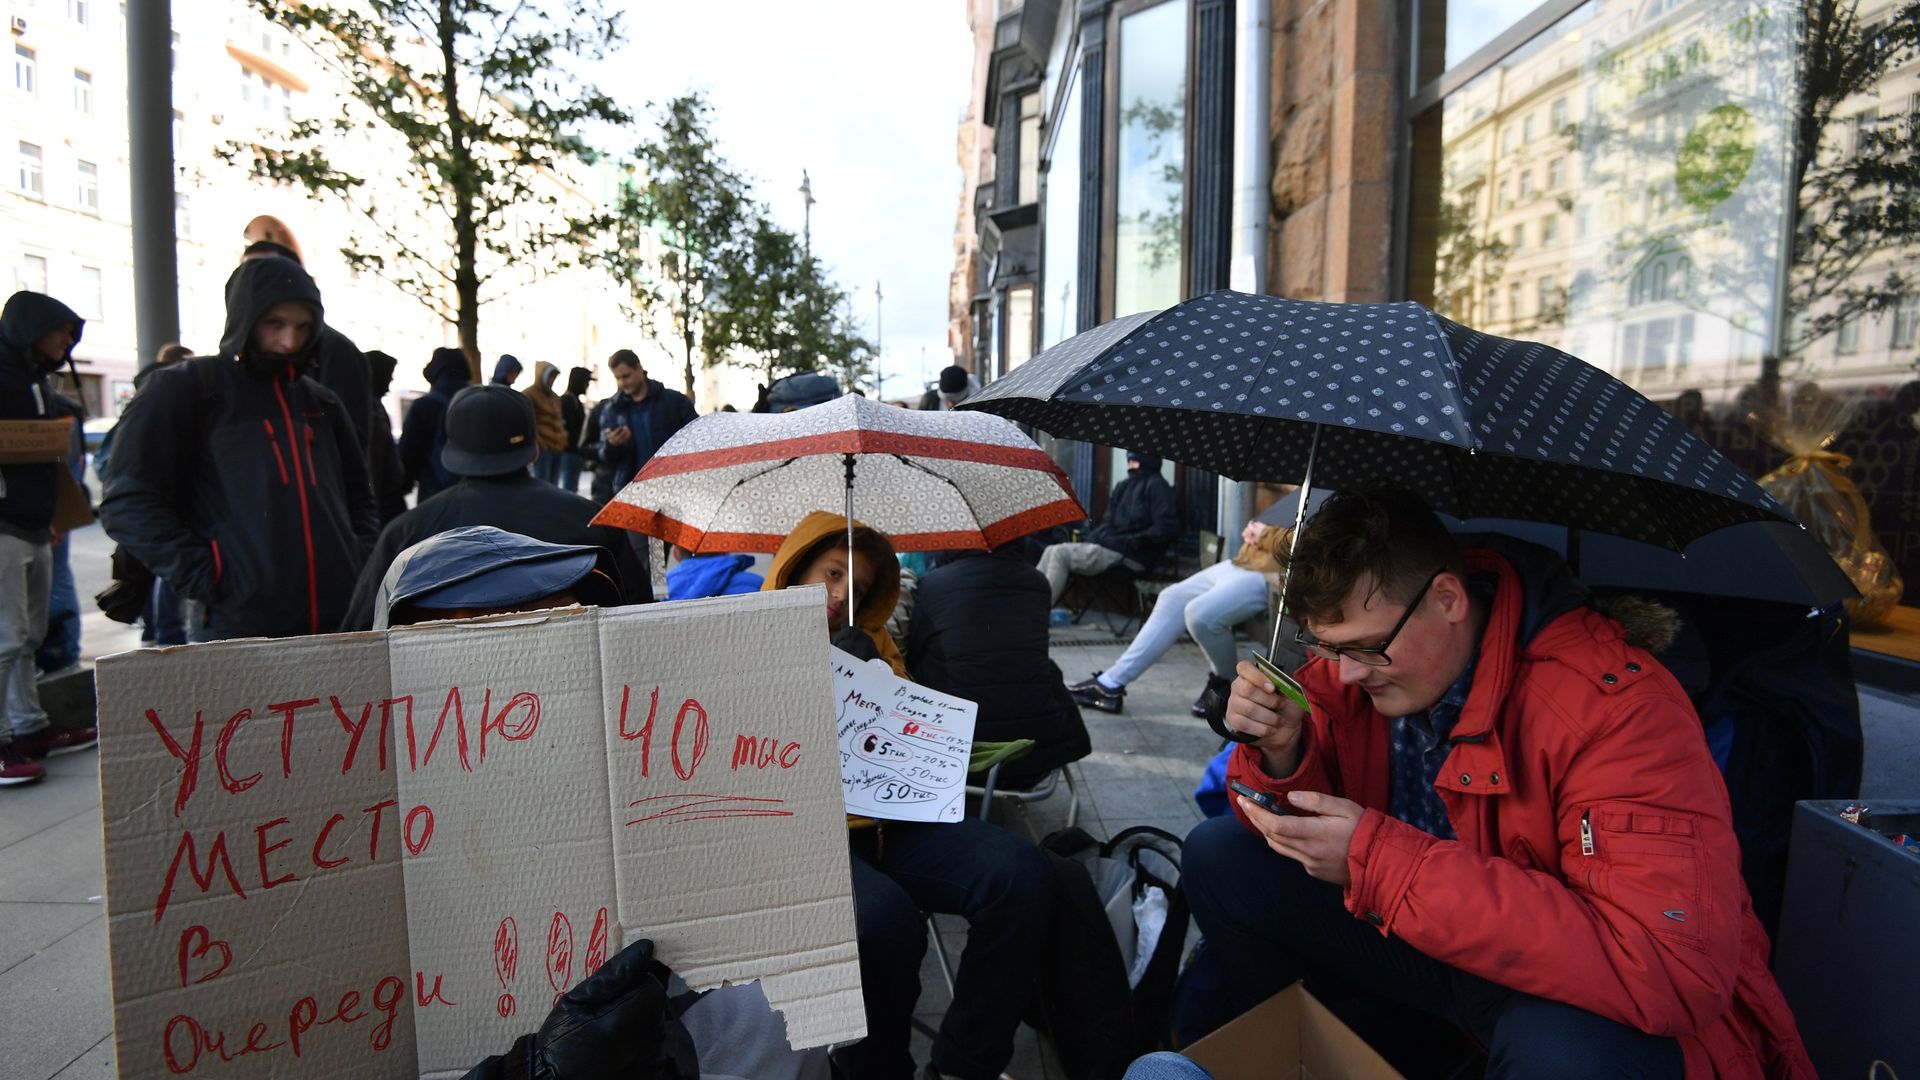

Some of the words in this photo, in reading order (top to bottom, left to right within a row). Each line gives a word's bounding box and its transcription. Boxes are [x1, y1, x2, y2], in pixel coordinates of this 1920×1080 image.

[145, 686, 542, 815] УСТУПЛЮ
[619, 685, 710, 781] 40
[903, 721, 919, 736] 60
[881, 783, 910, 800] 50
[155, 800, 436, 923] МЕСТО
[178, 925, 233, 987] В
